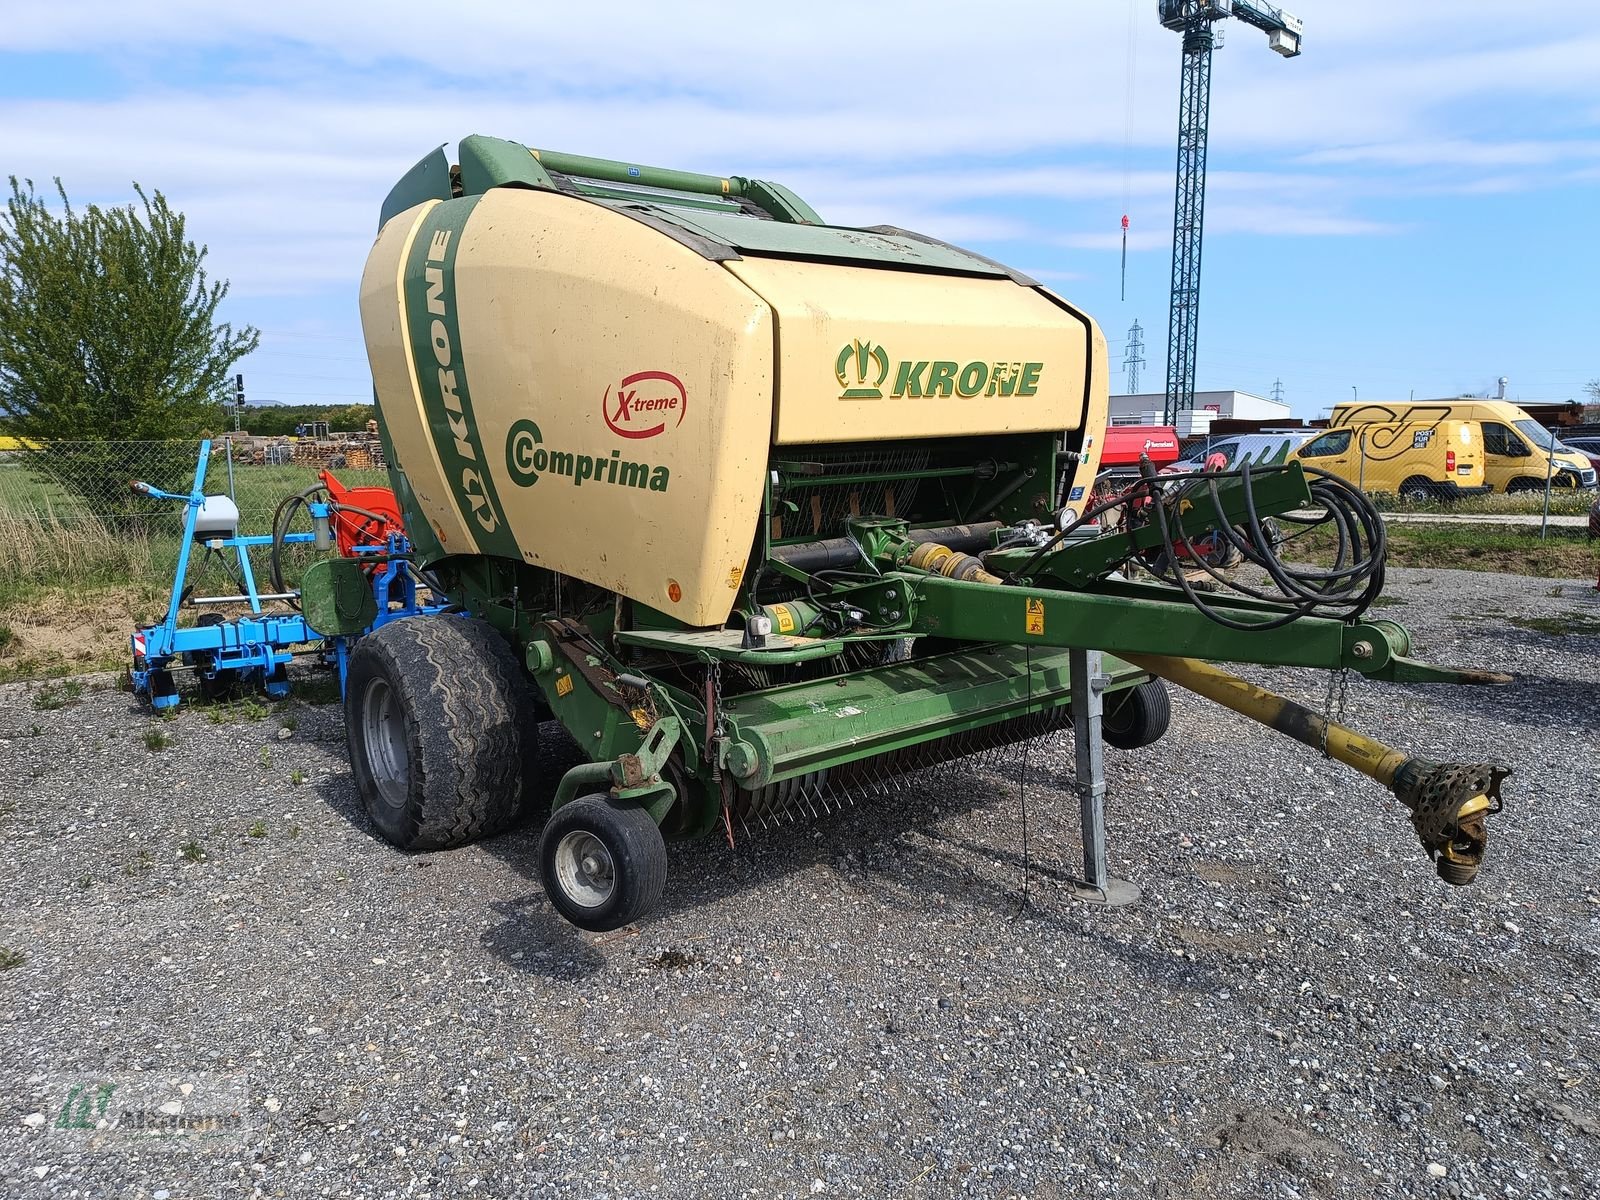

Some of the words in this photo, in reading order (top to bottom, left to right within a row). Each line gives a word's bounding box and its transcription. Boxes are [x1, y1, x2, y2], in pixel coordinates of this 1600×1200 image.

[425, 230, 476, 461] KRONE
[612, 390, 678, 422] X-treme
[890, 361, 1043, 399] KRONE
[506, 419, 670, 492] Comprima
